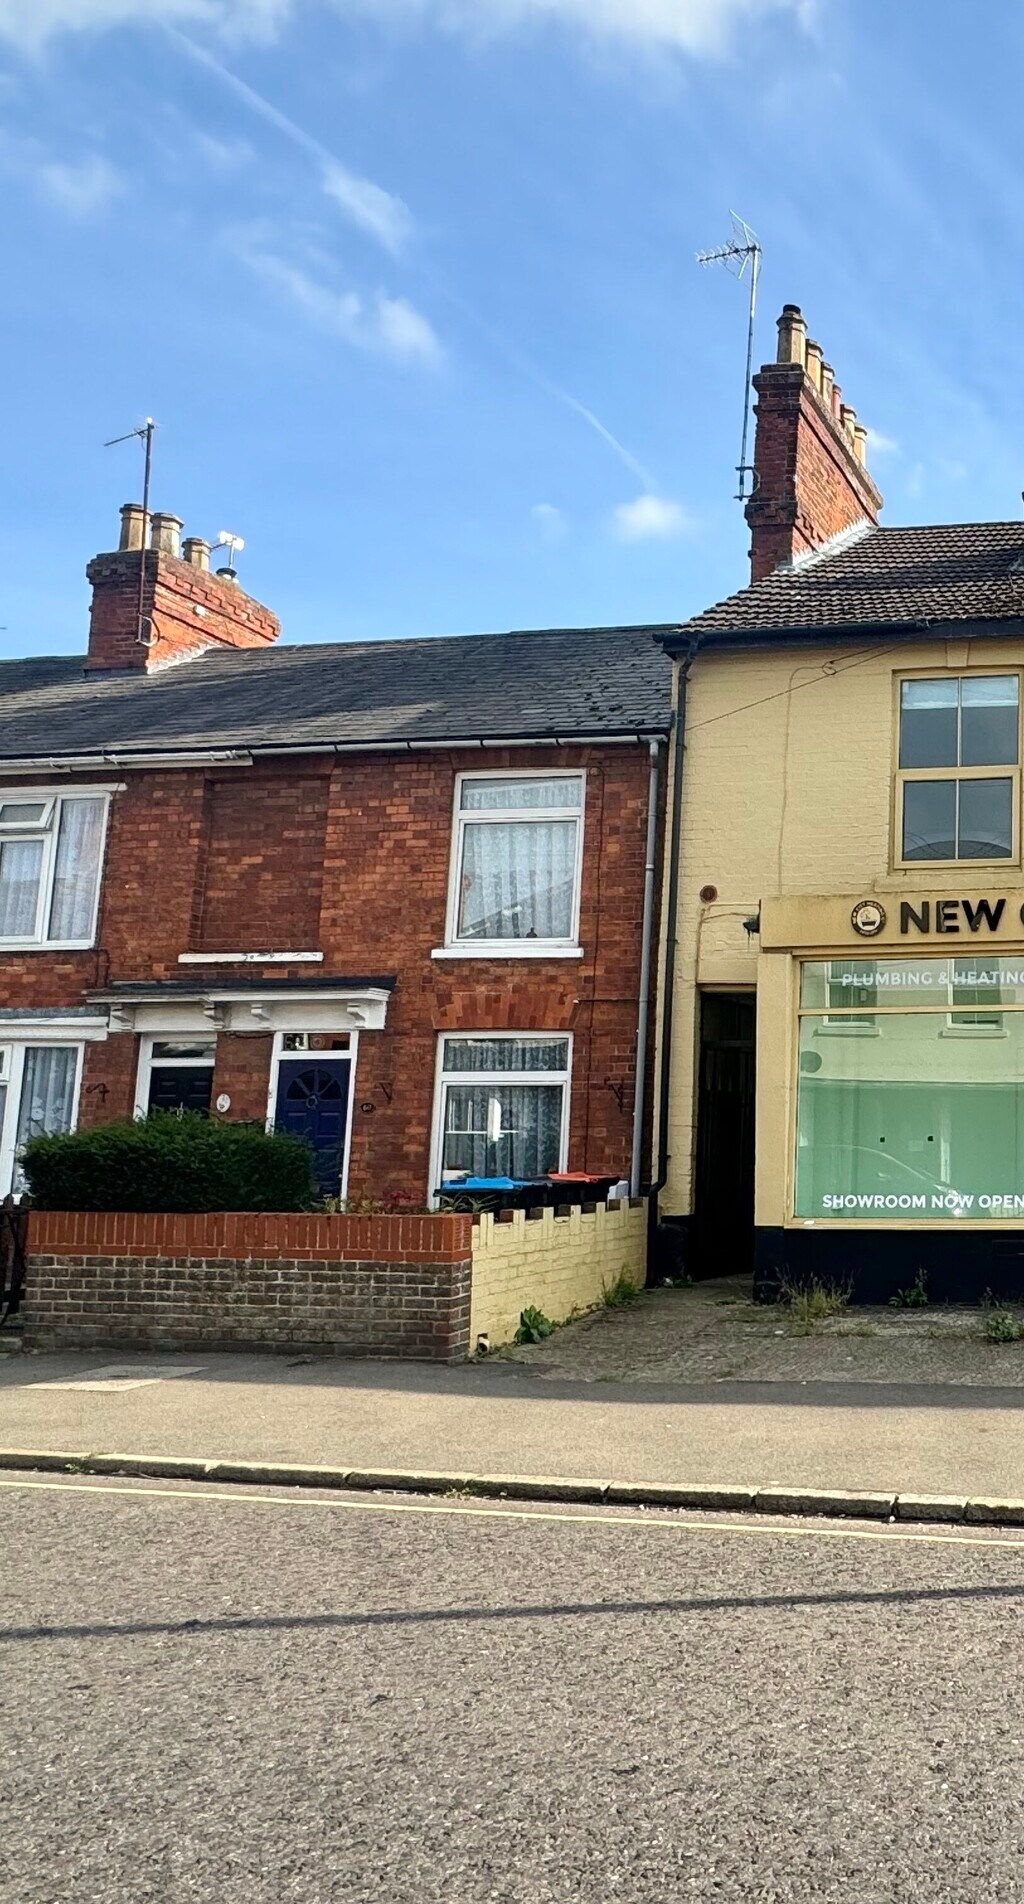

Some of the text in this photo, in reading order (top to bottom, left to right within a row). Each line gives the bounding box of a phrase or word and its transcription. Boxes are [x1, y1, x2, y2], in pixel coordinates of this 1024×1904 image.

[900, 898, 1006, 934] NEW
[841, 971, 932, 986] PLUMBING
[938, 972, 951, 985] &
[822, 1194, 926, 1208] SHOWROOM
[931, 1194, 974, 1208] NOW
